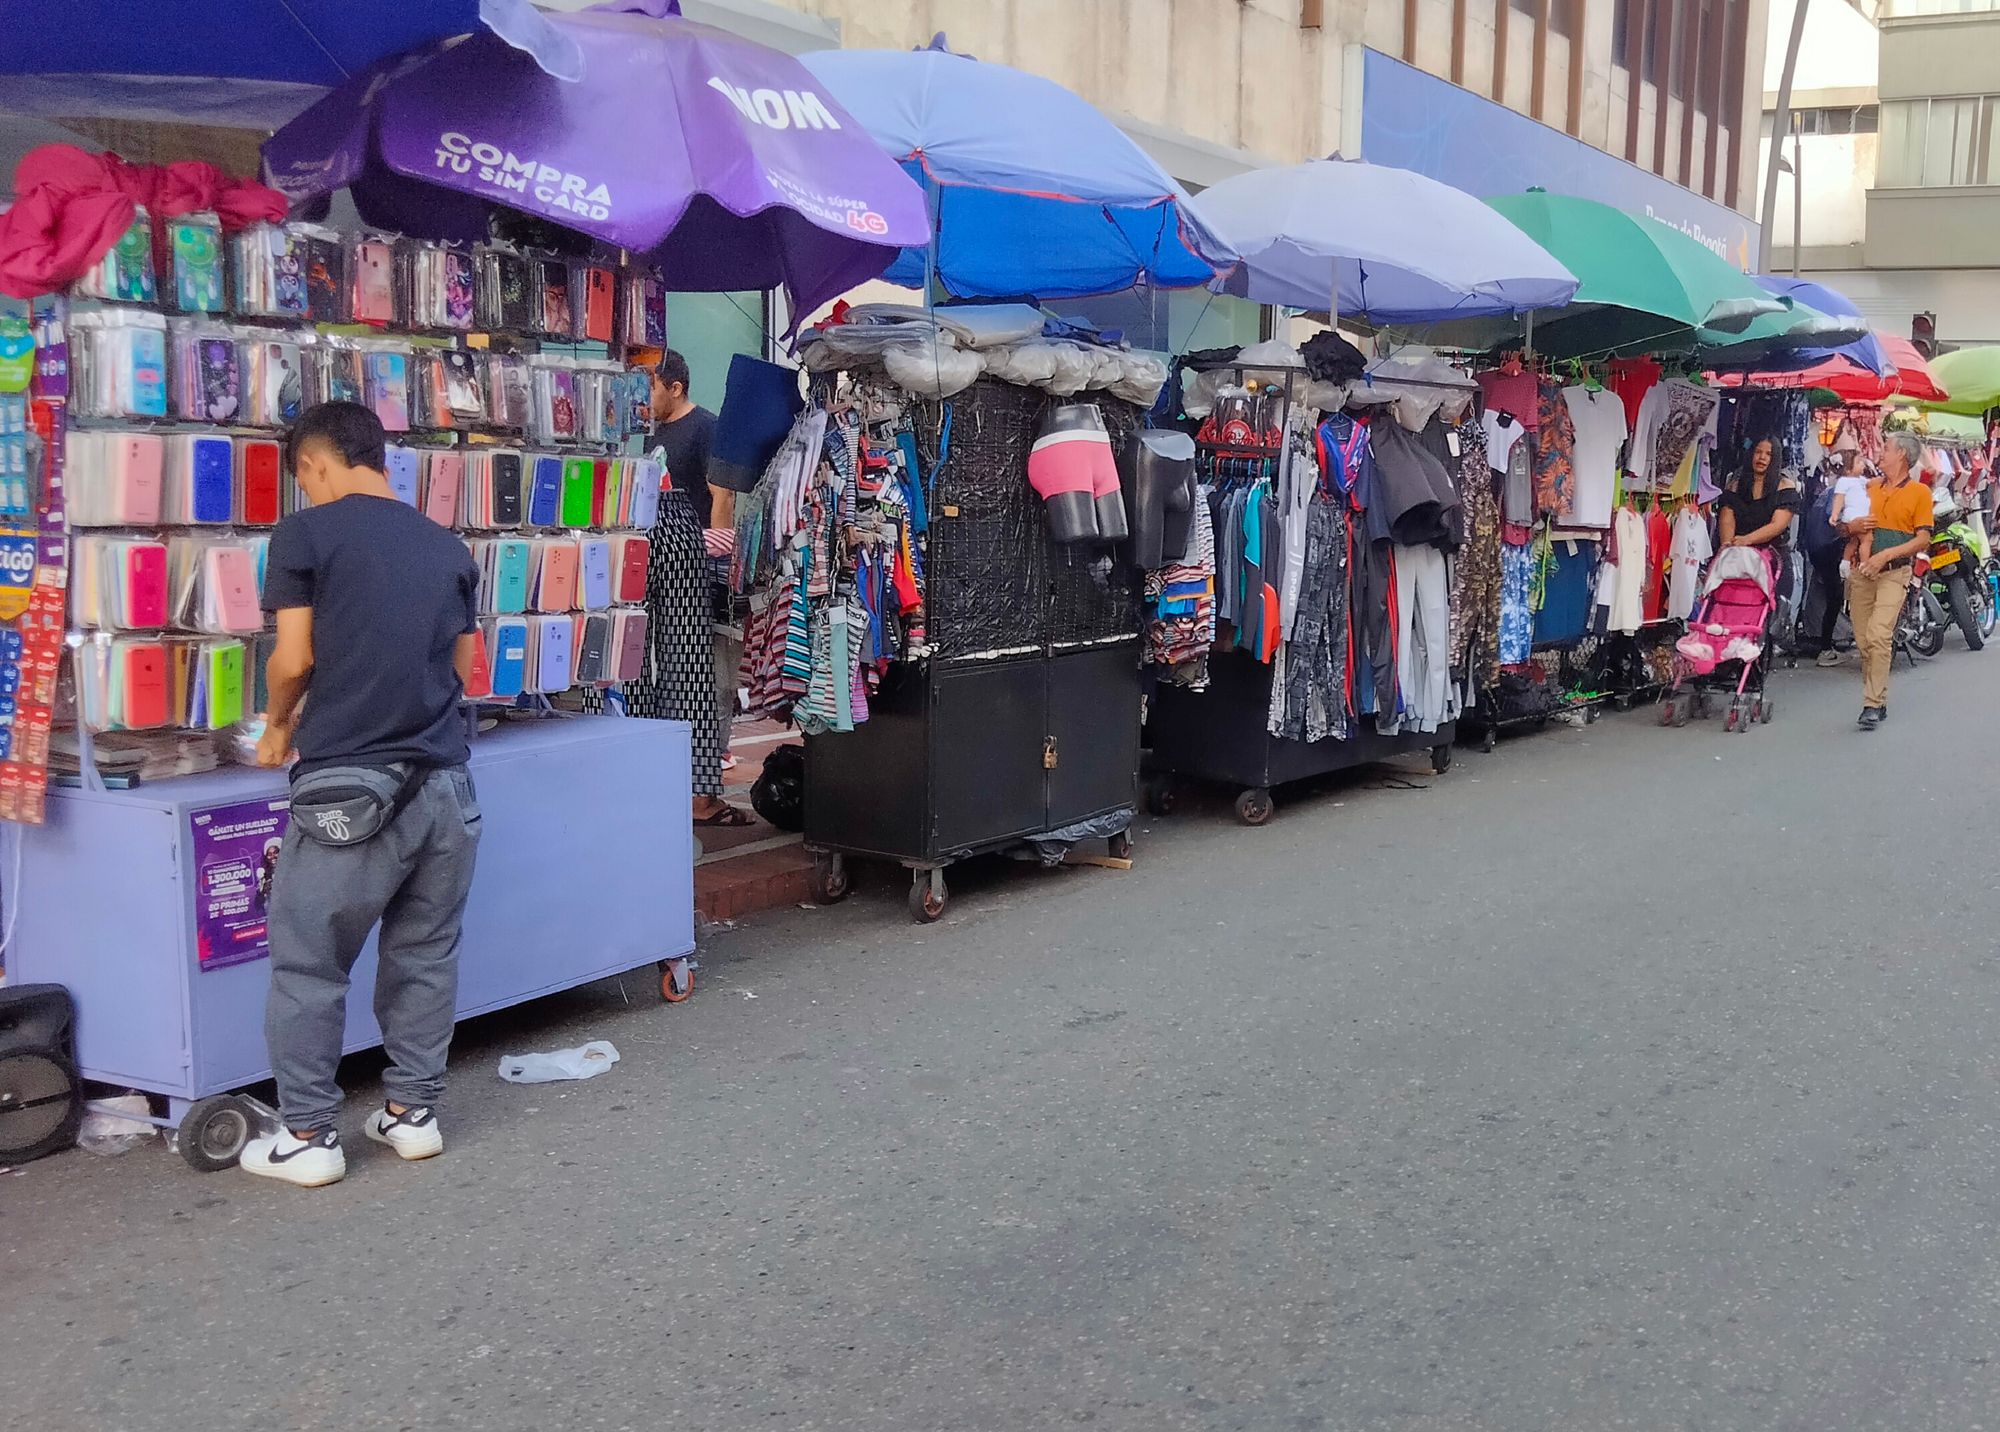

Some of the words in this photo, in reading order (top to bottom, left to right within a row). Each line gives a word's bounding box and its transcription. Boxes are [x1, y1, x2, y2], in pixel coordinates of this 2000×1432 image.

[434, 149, 471, 174] TU
[478, 165, 528, 193] SIM
[534, 185, 609, 221] CARD
[440, 132, 613, 207] COMPRA
[847, 210, 888, 234] 4G
